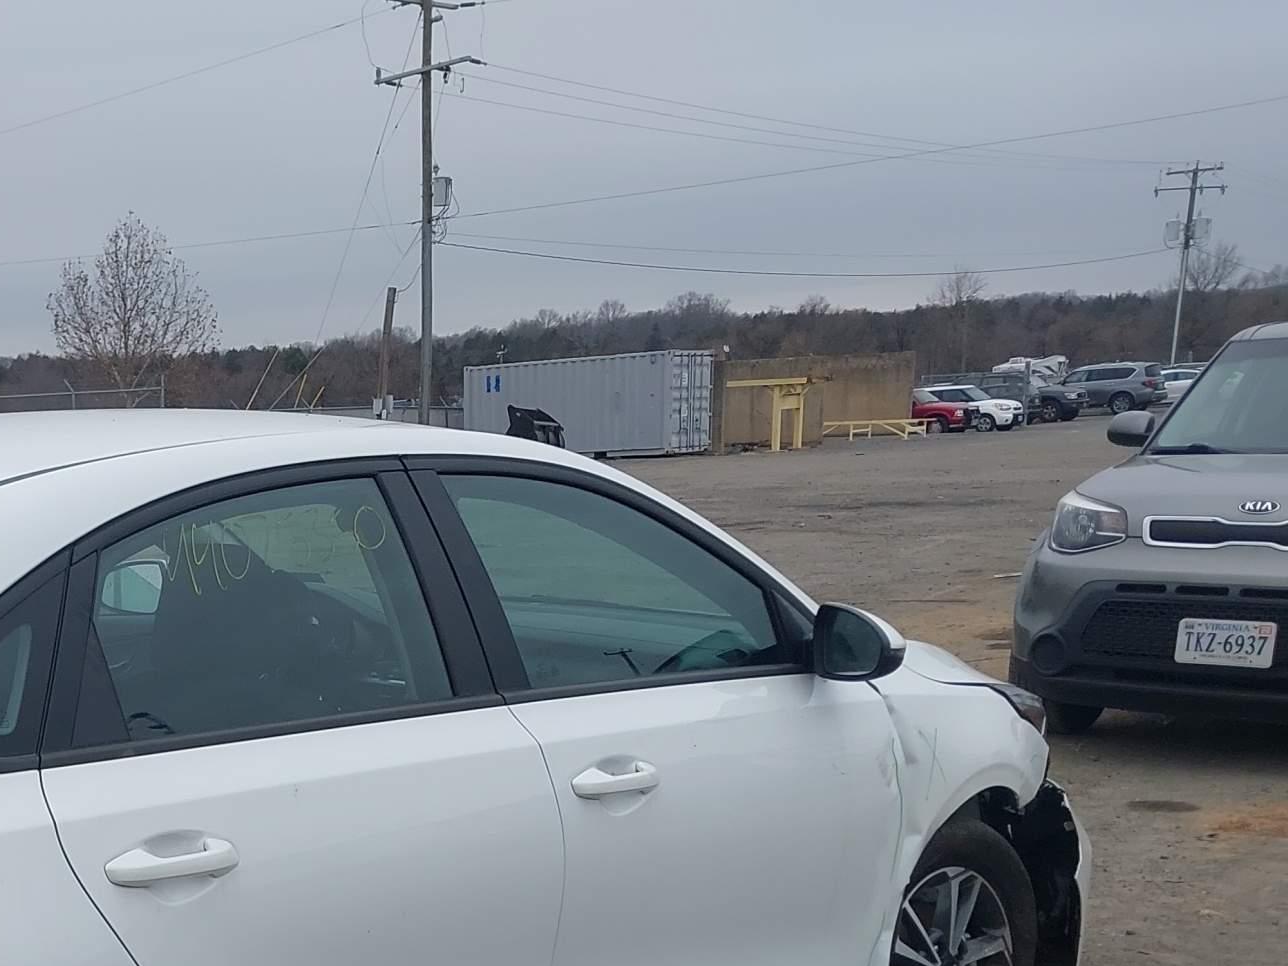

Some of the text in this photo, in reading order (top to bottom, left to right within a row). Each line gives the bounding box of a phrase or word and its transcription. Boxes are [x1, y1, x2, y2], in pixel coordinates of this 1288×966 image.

[1244, 500, 1273, 511] KIA
[1205, 622, 1251, 633] VIRGINIA
[1184, 631, 1270, 657] TKZ-6937
